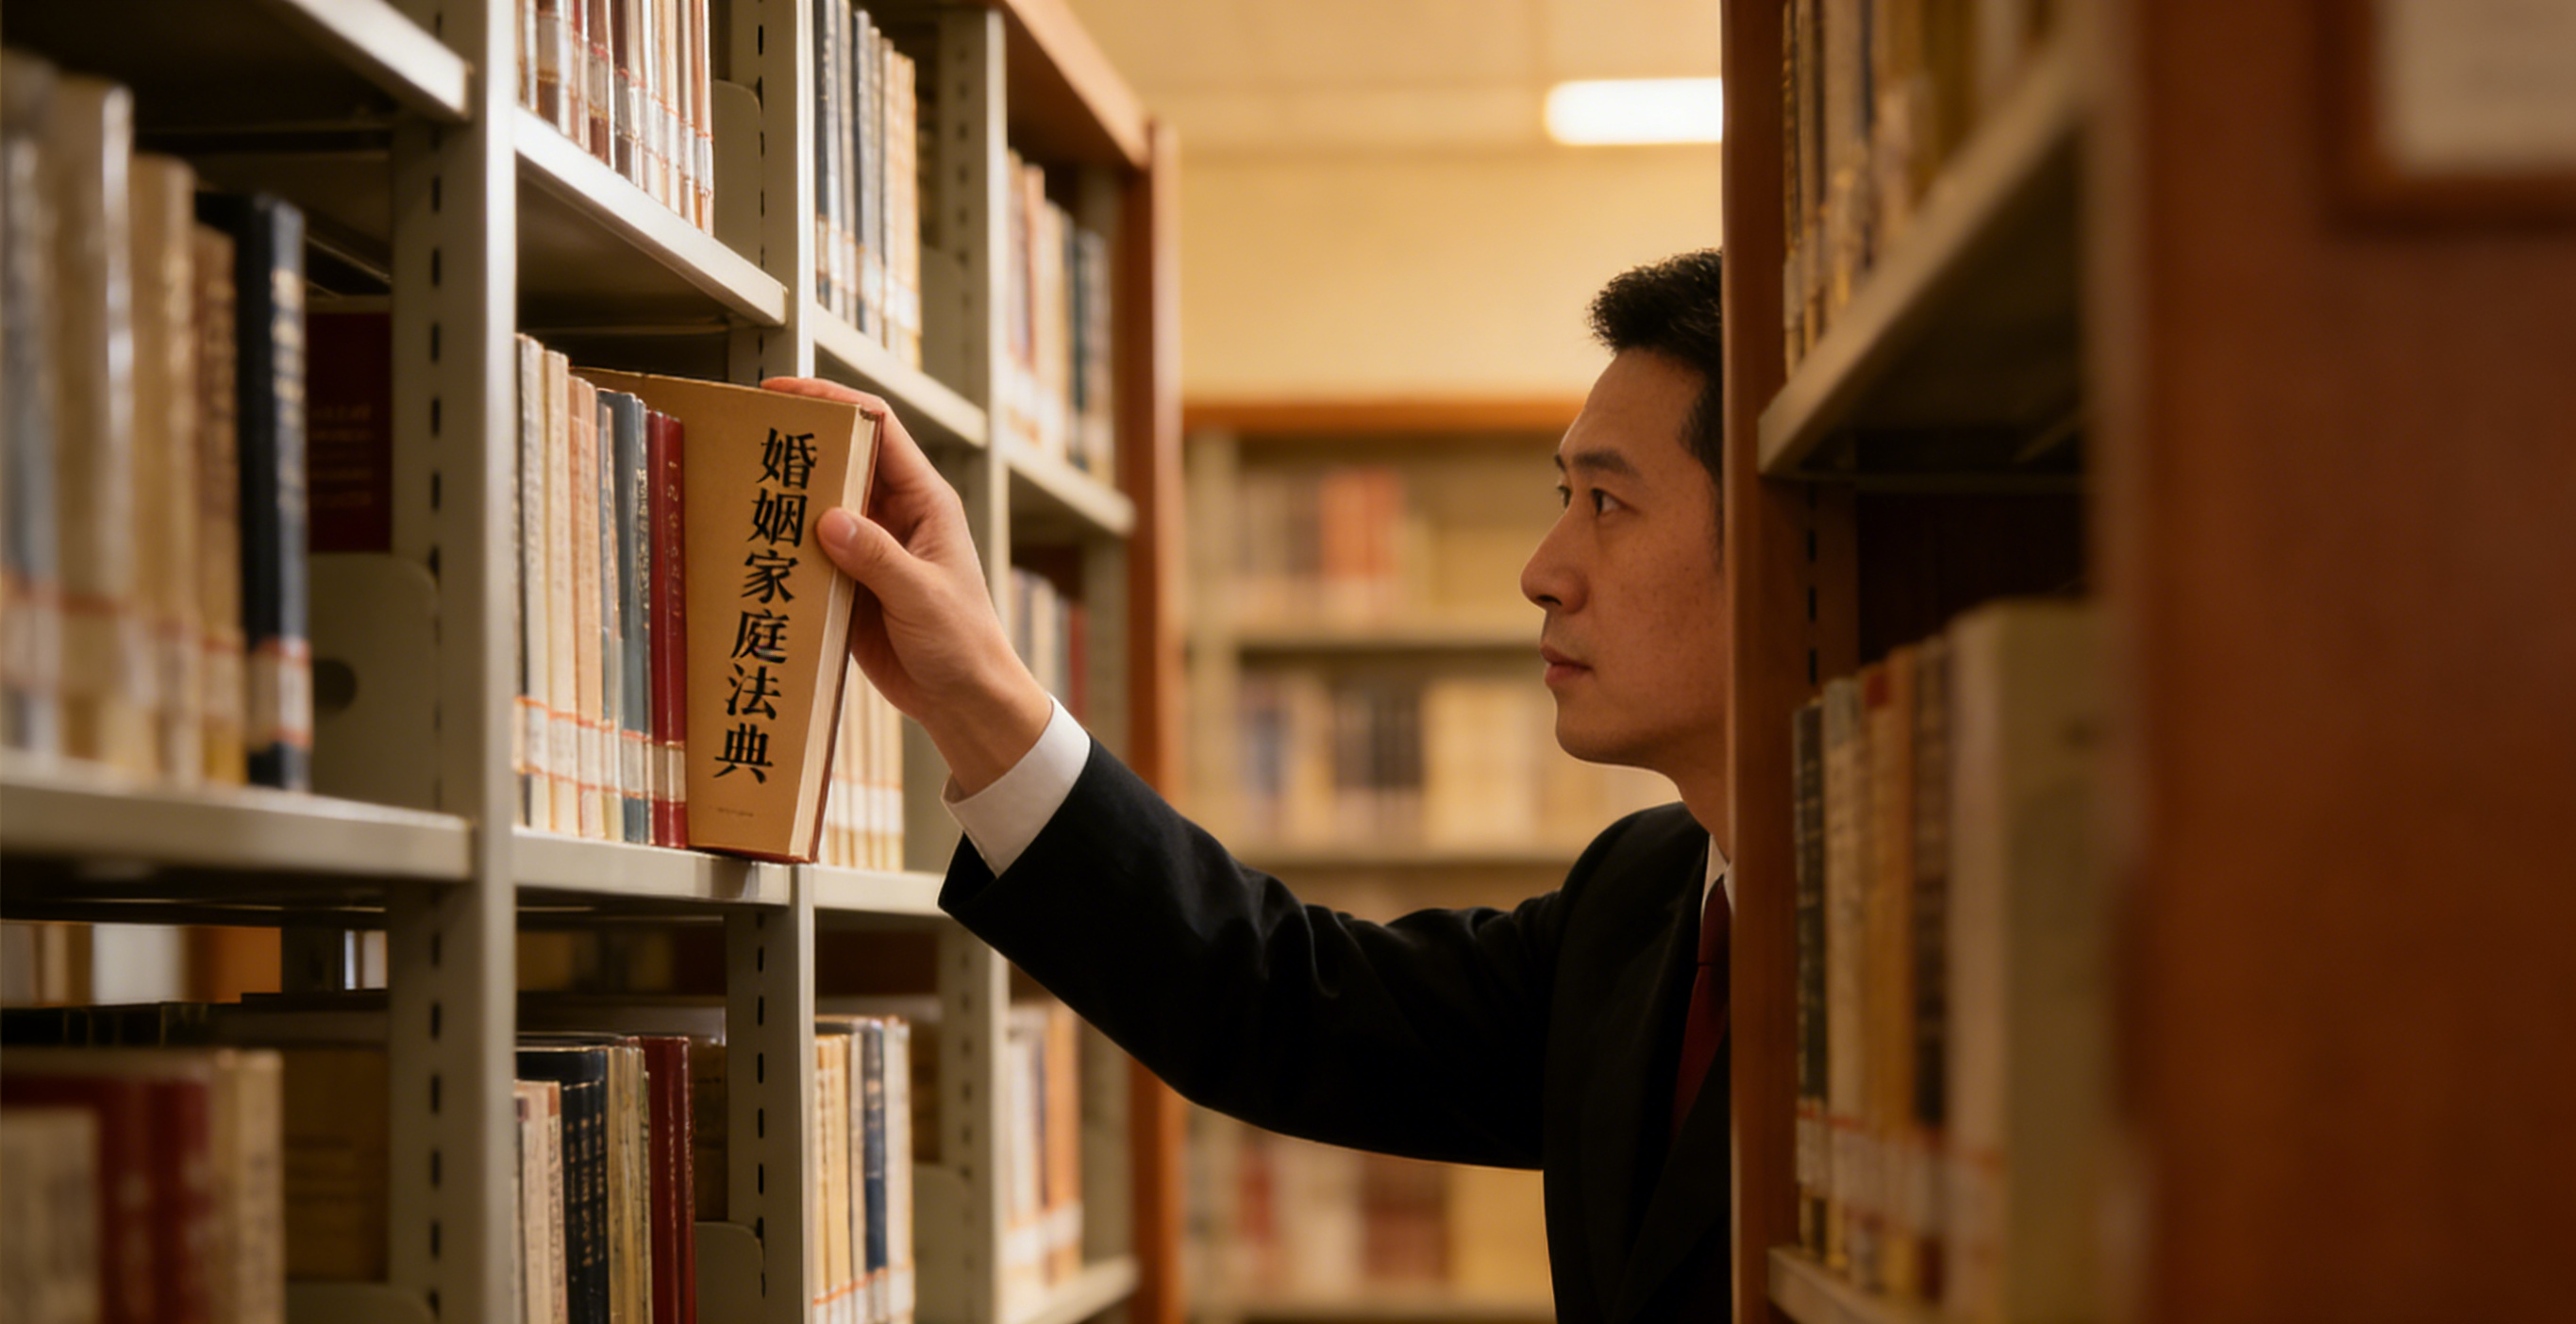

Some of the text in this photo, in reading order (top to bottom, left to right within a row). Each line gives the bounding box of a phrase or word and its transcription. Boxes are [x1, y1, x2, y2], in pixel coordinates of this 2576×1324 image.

[713, 427, 817, 784] 婚姻家庭法典
